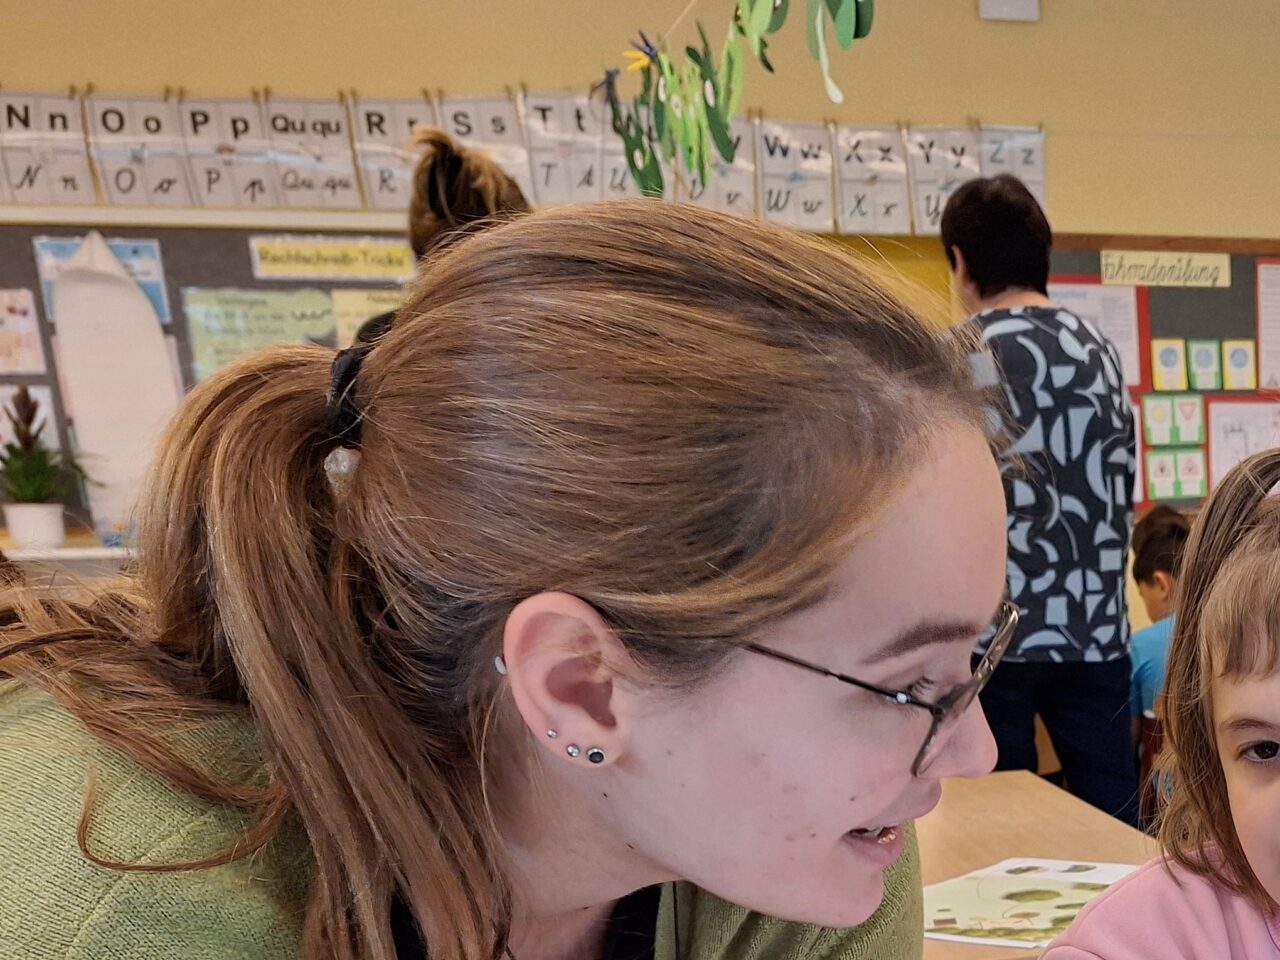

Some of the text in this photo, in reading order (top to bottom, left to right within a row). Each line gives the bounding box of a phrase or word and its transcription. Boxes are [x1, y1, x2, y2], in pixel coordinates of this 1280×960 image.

[7, 104, 68, 130] N n
[101, 108, 162, 134] O o
[190, 110, 249, 140] P p
[271, 113, 340, 137] Qu qu
[366, 111, 386, 135] R
[453, 111, 505, 136] S s
[534, 106, 585, 131] T t
[764, 135, 789, 158] W
[845, 140, 893, 162] X x
[918, 140, 965, 168] Y y
[989, 140, 1035, 165] Z z
[14, 164, 78, 191] N n
[115, 167, 136, 194] O
[206, 169, 221, 193] P
[541, 162, 557, 186] T
